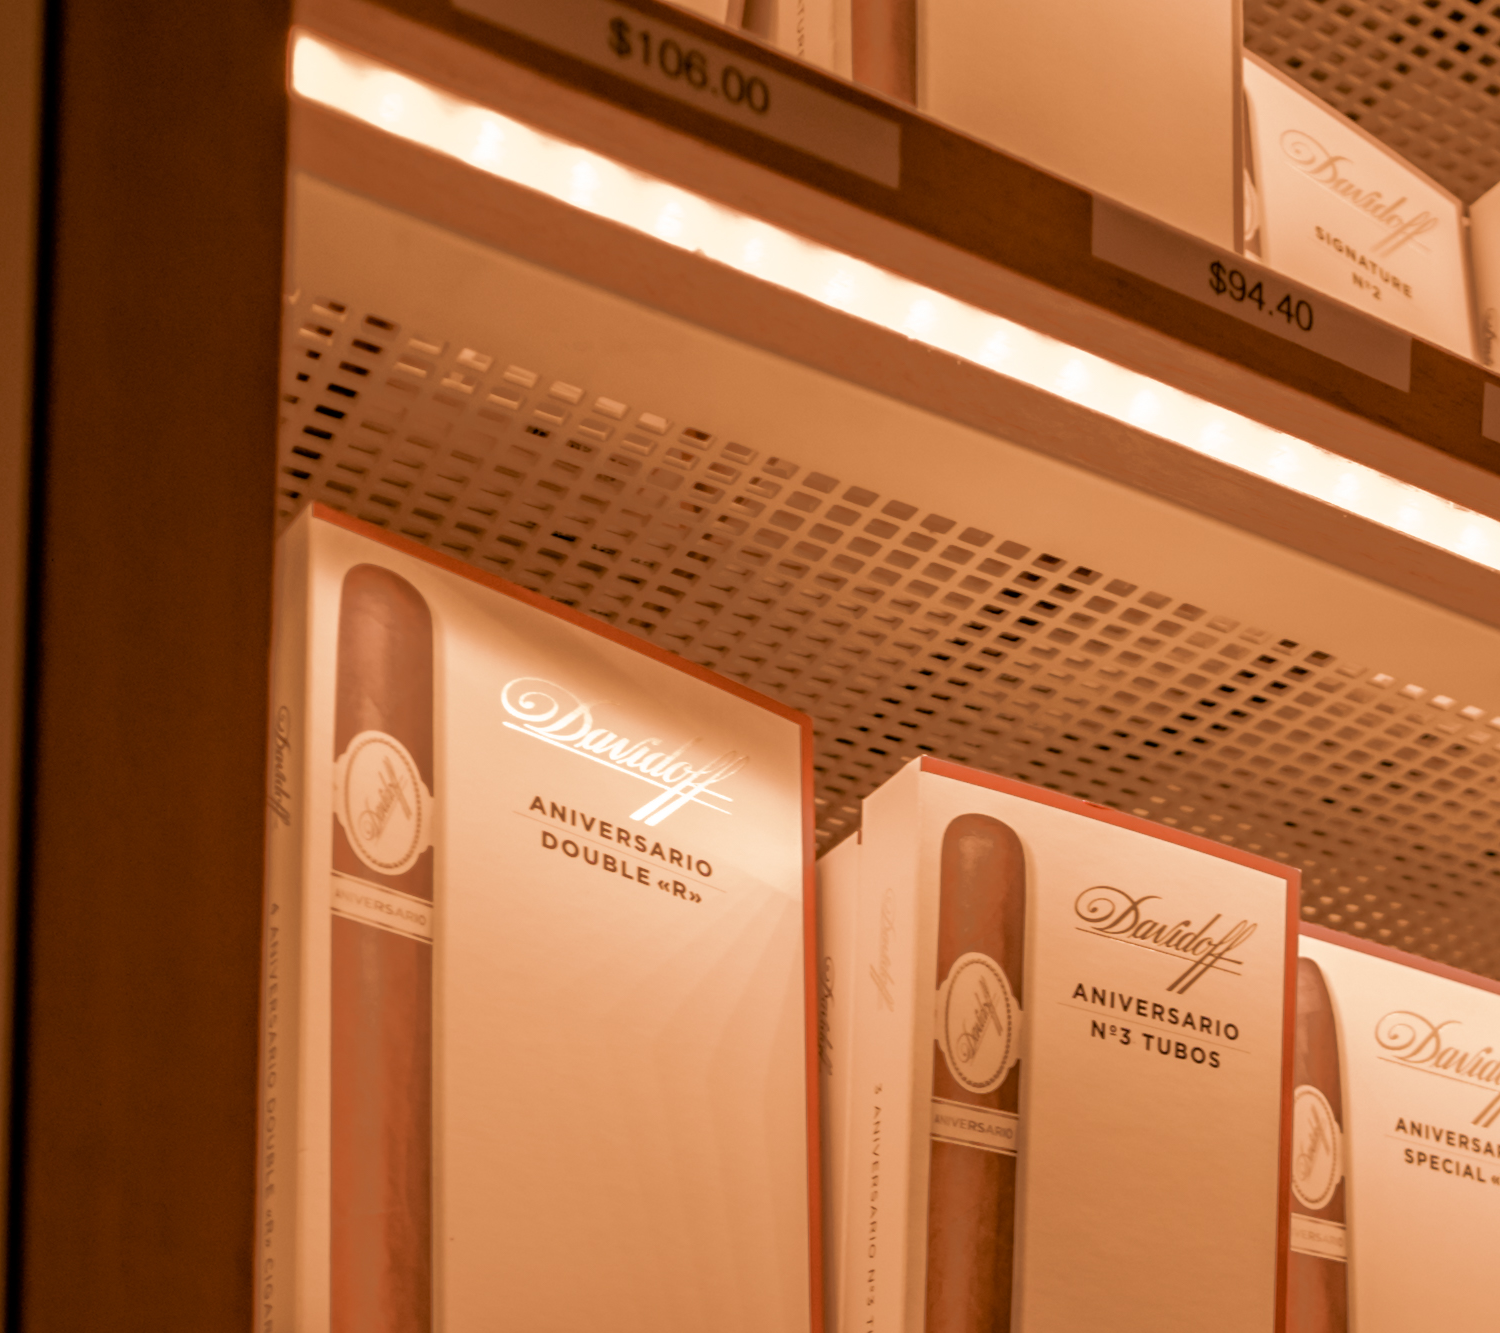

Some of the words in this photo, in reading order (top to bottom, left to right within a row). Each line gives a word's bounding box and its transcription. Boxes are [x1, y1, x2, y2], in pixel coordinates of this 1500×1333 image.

[607, 17, 770, 117] $106.00
[1279, 129, 1440, 258] Davidoff
[1209, 260, 1314, 332] $94.40
[1315, 225, 1413, 299] SIGNATURE
[500, 676, 750, 826] Davidoff
[528, 795, 713, 878] ANIVERSARIO
[541, 830, 651, 887] DOUBLE
[657, 878, 703, 904] «R»
[335, 889, 427, 927] ANIVERSARIO
[1074, 885, 1258, 994] Davidoff
[1072, 983, 1239, 1041] ANIVERSARIO
[1091, 1020, 1131, 1046] Nº3
[1143, 1034, 1221, 1069] TUBOS
[934, 1114, 1014, 1140] ANIVERSARIO
[867, 1106, 882, 1258] ANIVERSARIO
[1404, 1148, 1486, 1183] SPECIAL
